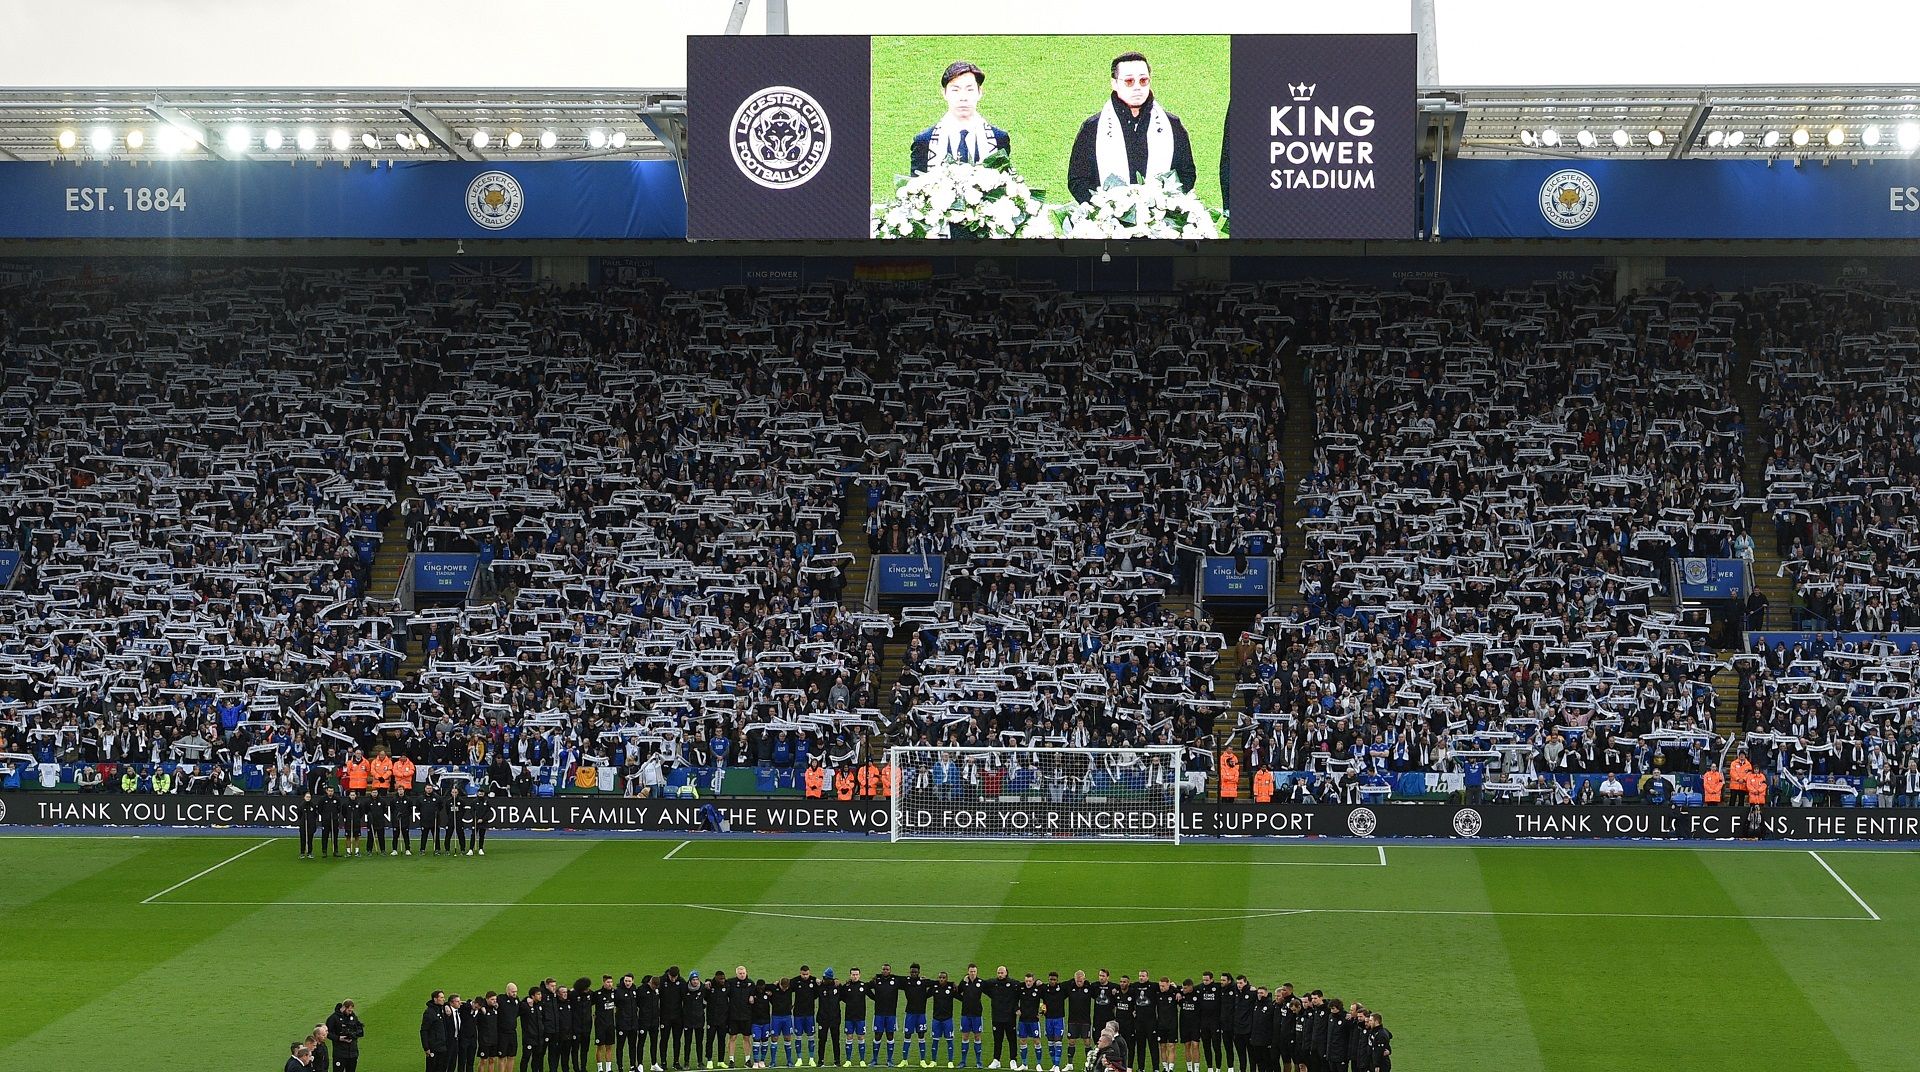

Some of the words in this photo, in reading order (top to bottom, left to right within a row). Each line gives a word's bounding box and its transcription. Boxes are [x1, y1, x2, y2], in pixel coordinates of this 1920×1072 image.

[738, 93, 803, 134] LEICESTER
[802, 104, 825, 135] CITY
[1270, 105, 1375, 137] KING
[737, 141, 799, 182] FOOTBALL
[798, 141, 824, 174] CLUB
[1270, 141, 1374, 165] POWER
[471, 175, 507, 198] LEICESTER
[506, 182, 519, 198] CITY
[1270, 169, 1375, 190] STADIUM
[1545, 174, 1582, 198] LEICESTER
[1581, 180, 1594, 197] CITY
[66, 188, 115, 211] EST.
[123, 187, 189, 211] 1884
[470, 202, 505, 225] FOOTBALL
[504, 202, 519, 221] CLUB
[1545, 201, 1580, 225] FOOTBALL
[1556, 270, 1575, 280] SK3
[423, 564, 442, 572] KING
[443, 564, 468, 572] POWER
[38, 803, 111, 820] THANK
[121, 803, 165, 820] YOU
[177, 804, 233, 821] LCFC
[461, 805, 560, 823] OTBALL
[571, 807, 647, 824] FAMILY
[766, 809, 837, 826] WIDER
[943, 810, 986, 828] FOR
[1070, 811, 1203, 830] INCREDIBLE
[1214, 813, 1314, 831] SUPPORT
[1515, 814, 1592, 831] THANK
[1602, 815, 1648, 832] YOU
[1731, 816, 1795, 835] FNS,
[1806, 816, 1846, 833] THE
